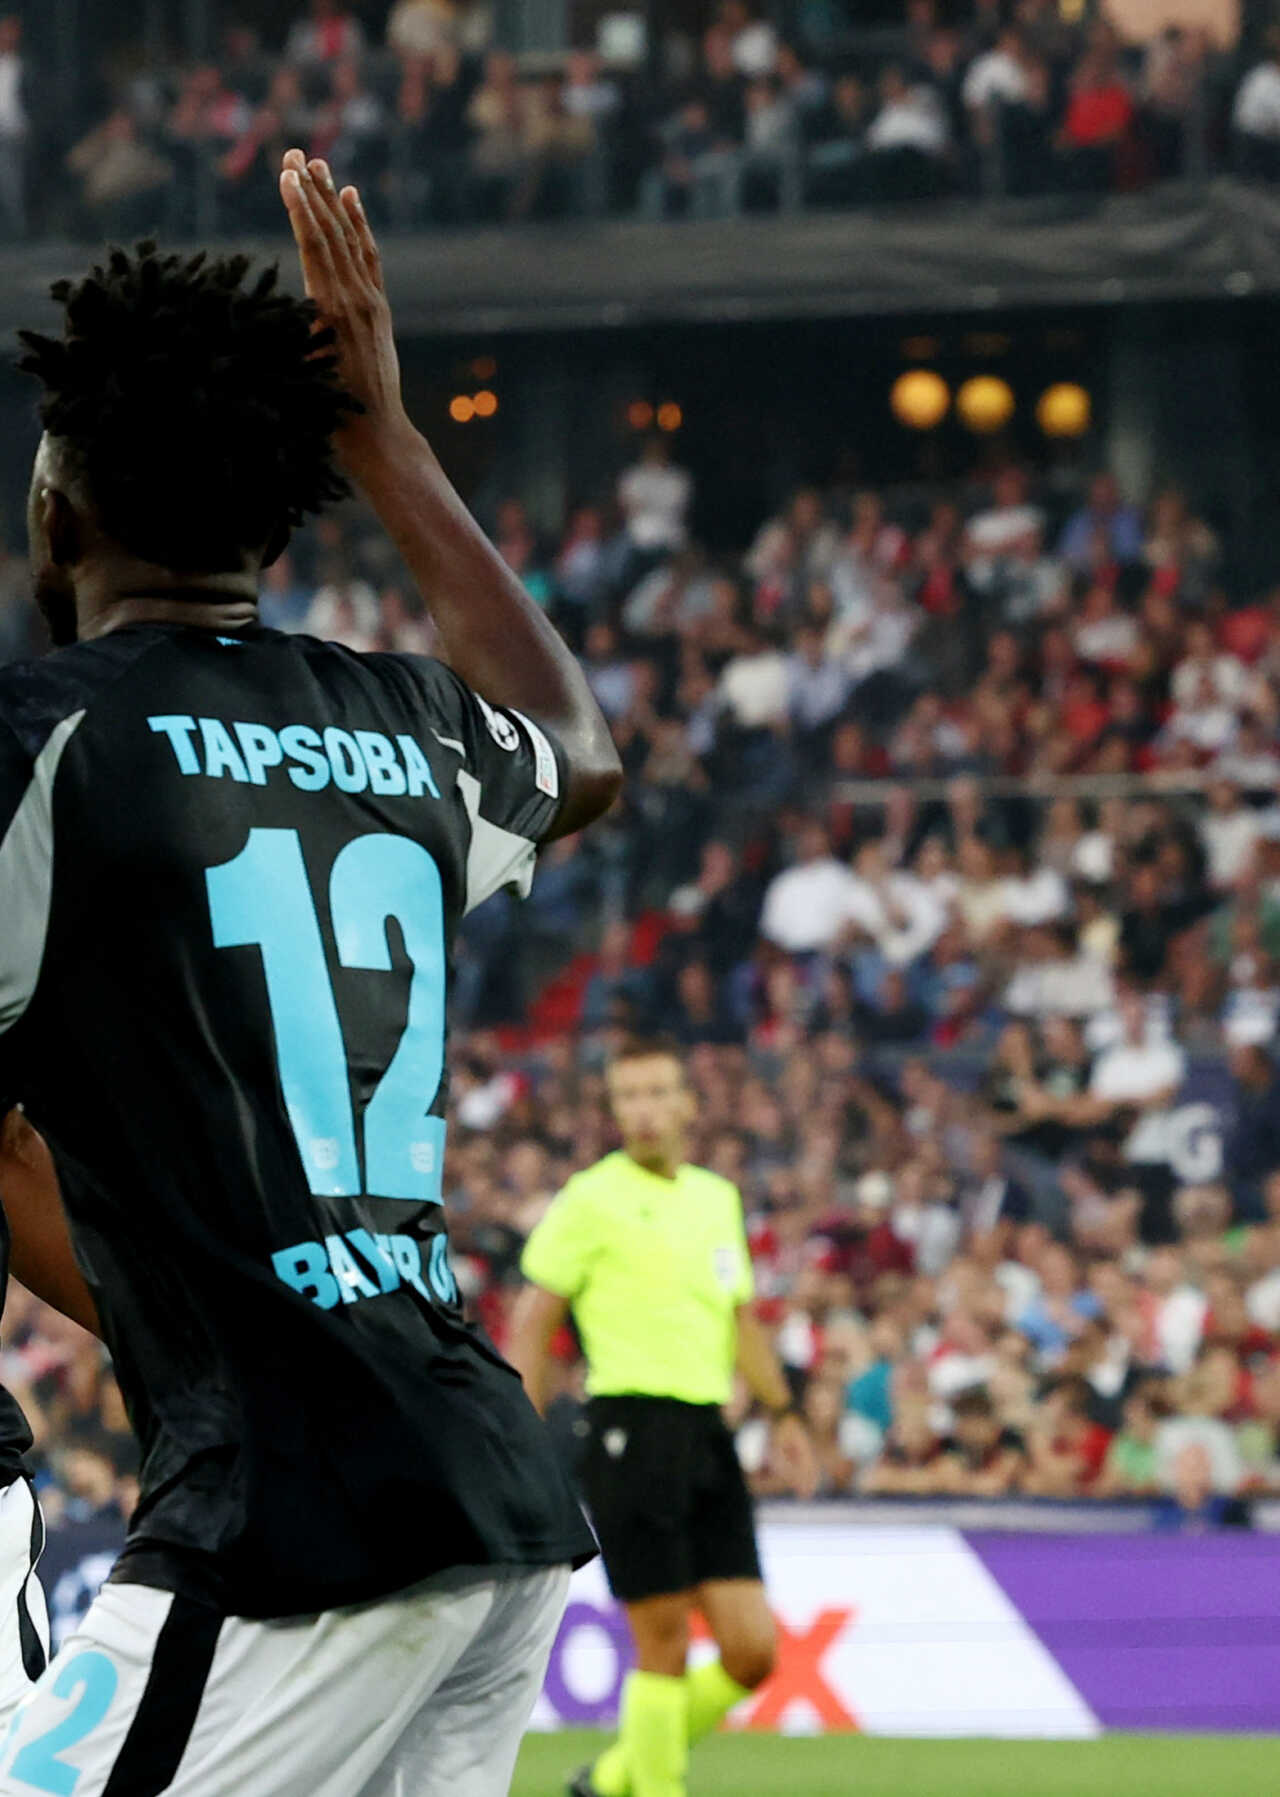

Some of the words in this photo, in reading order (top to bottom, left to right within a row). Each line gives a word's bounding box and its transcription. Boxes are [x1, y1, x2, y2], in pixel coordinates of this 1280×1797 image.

[147, 714, 441, 799] TAPSOBA
[205, 827, 448, 1206] 12
[271, 1227, 431, 1310] BAYR
